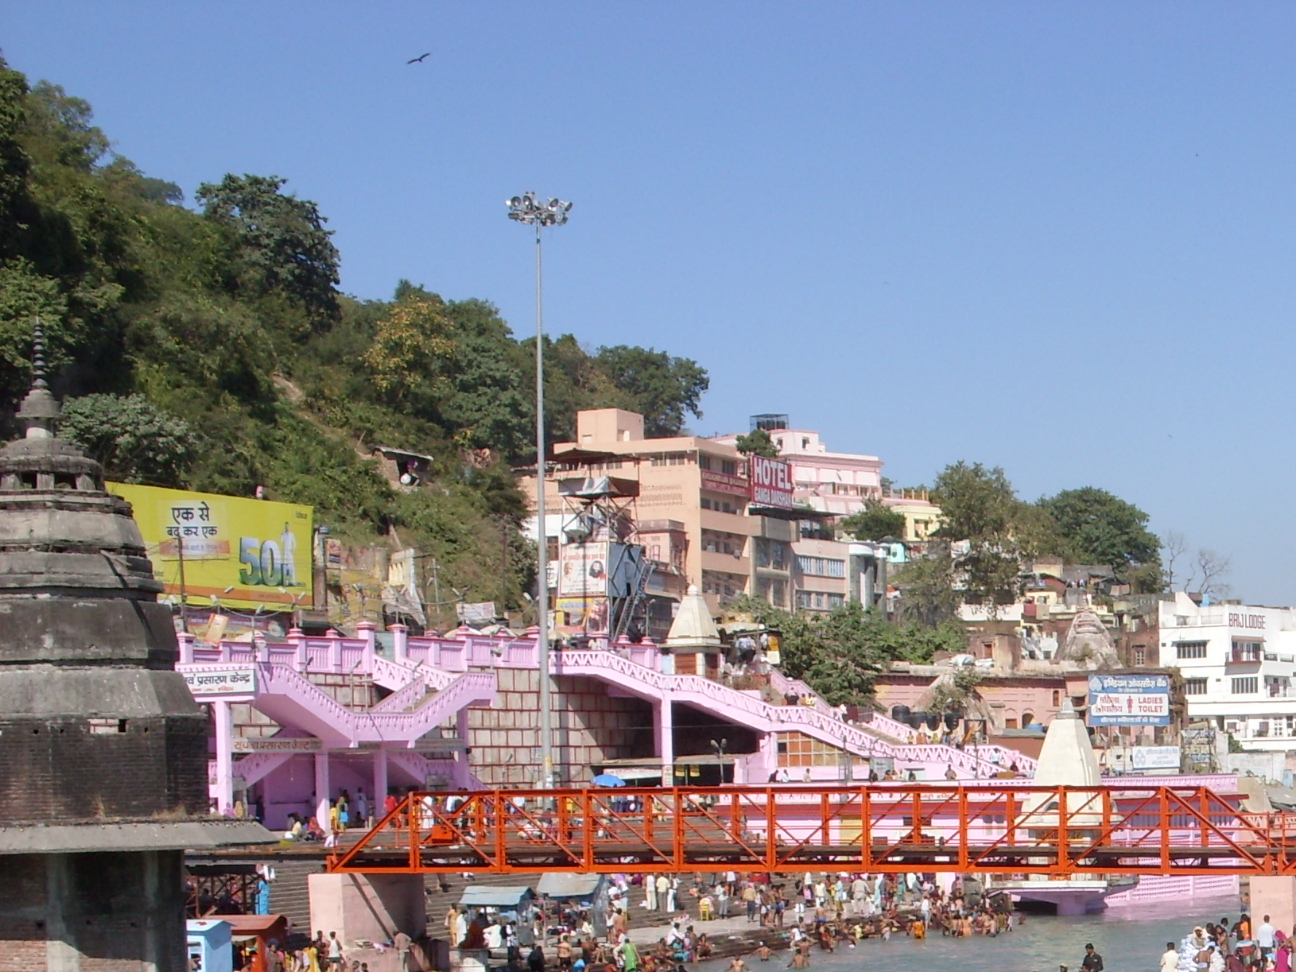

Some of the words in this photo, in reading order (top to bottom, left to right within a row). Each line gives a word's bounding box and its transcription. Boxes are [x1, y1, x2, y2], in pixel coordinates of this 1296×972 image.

[754, 457, 792, 489] HOTEL
[171, 507, 195, 525] एक
[198, 501, 210, 521] से
[182, 526, 199, 537] कर
[201, 526, 218, 539] एक
[1229, 613, 1244, 628] BRIJ
[1245, 614, 1266, 629] LODGE
[185, 673, 196, 685] वं
[197, 675, 227, 687] प्रसारण
[229, 672, 251, 684] केन्द्र
[1138, 705, 1163, 713] TOILET
